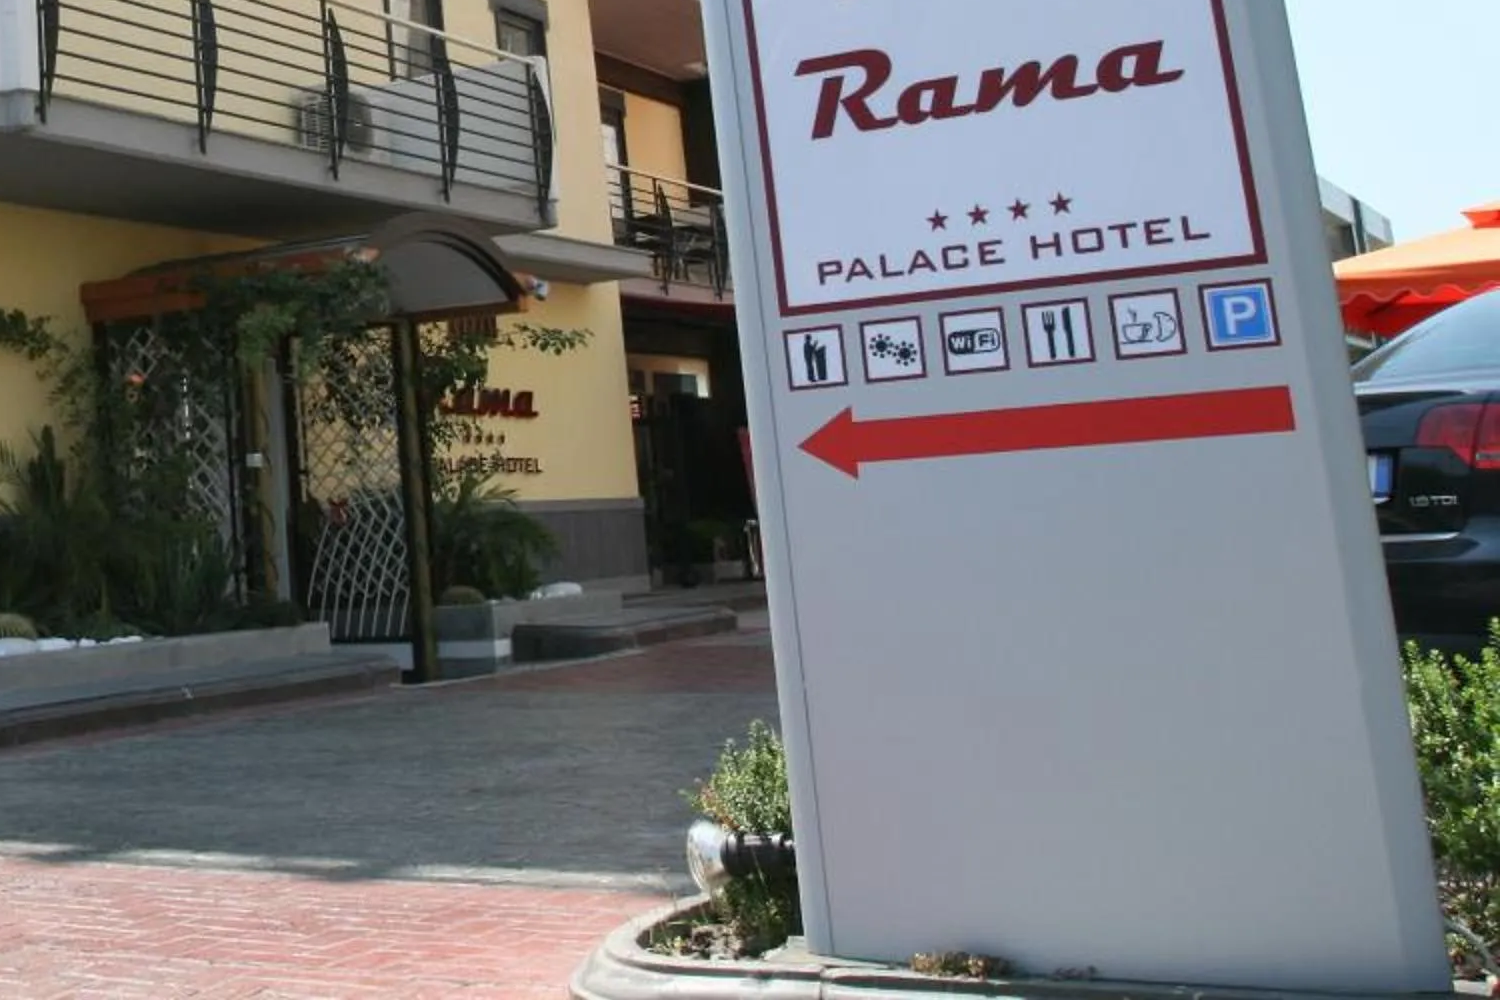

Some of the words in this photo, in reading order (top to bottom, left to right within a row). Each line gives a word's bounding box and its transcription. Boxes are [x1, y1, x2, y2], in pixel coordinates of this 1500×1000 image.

[794, 40, 1184, 140] Rama
[817, 239, 1005, 286] PALACE
[1030, 216, 1211, 260] HOTEL
[1222, 296, 1257, 336] P
[438, 387, 539, 418] ama
